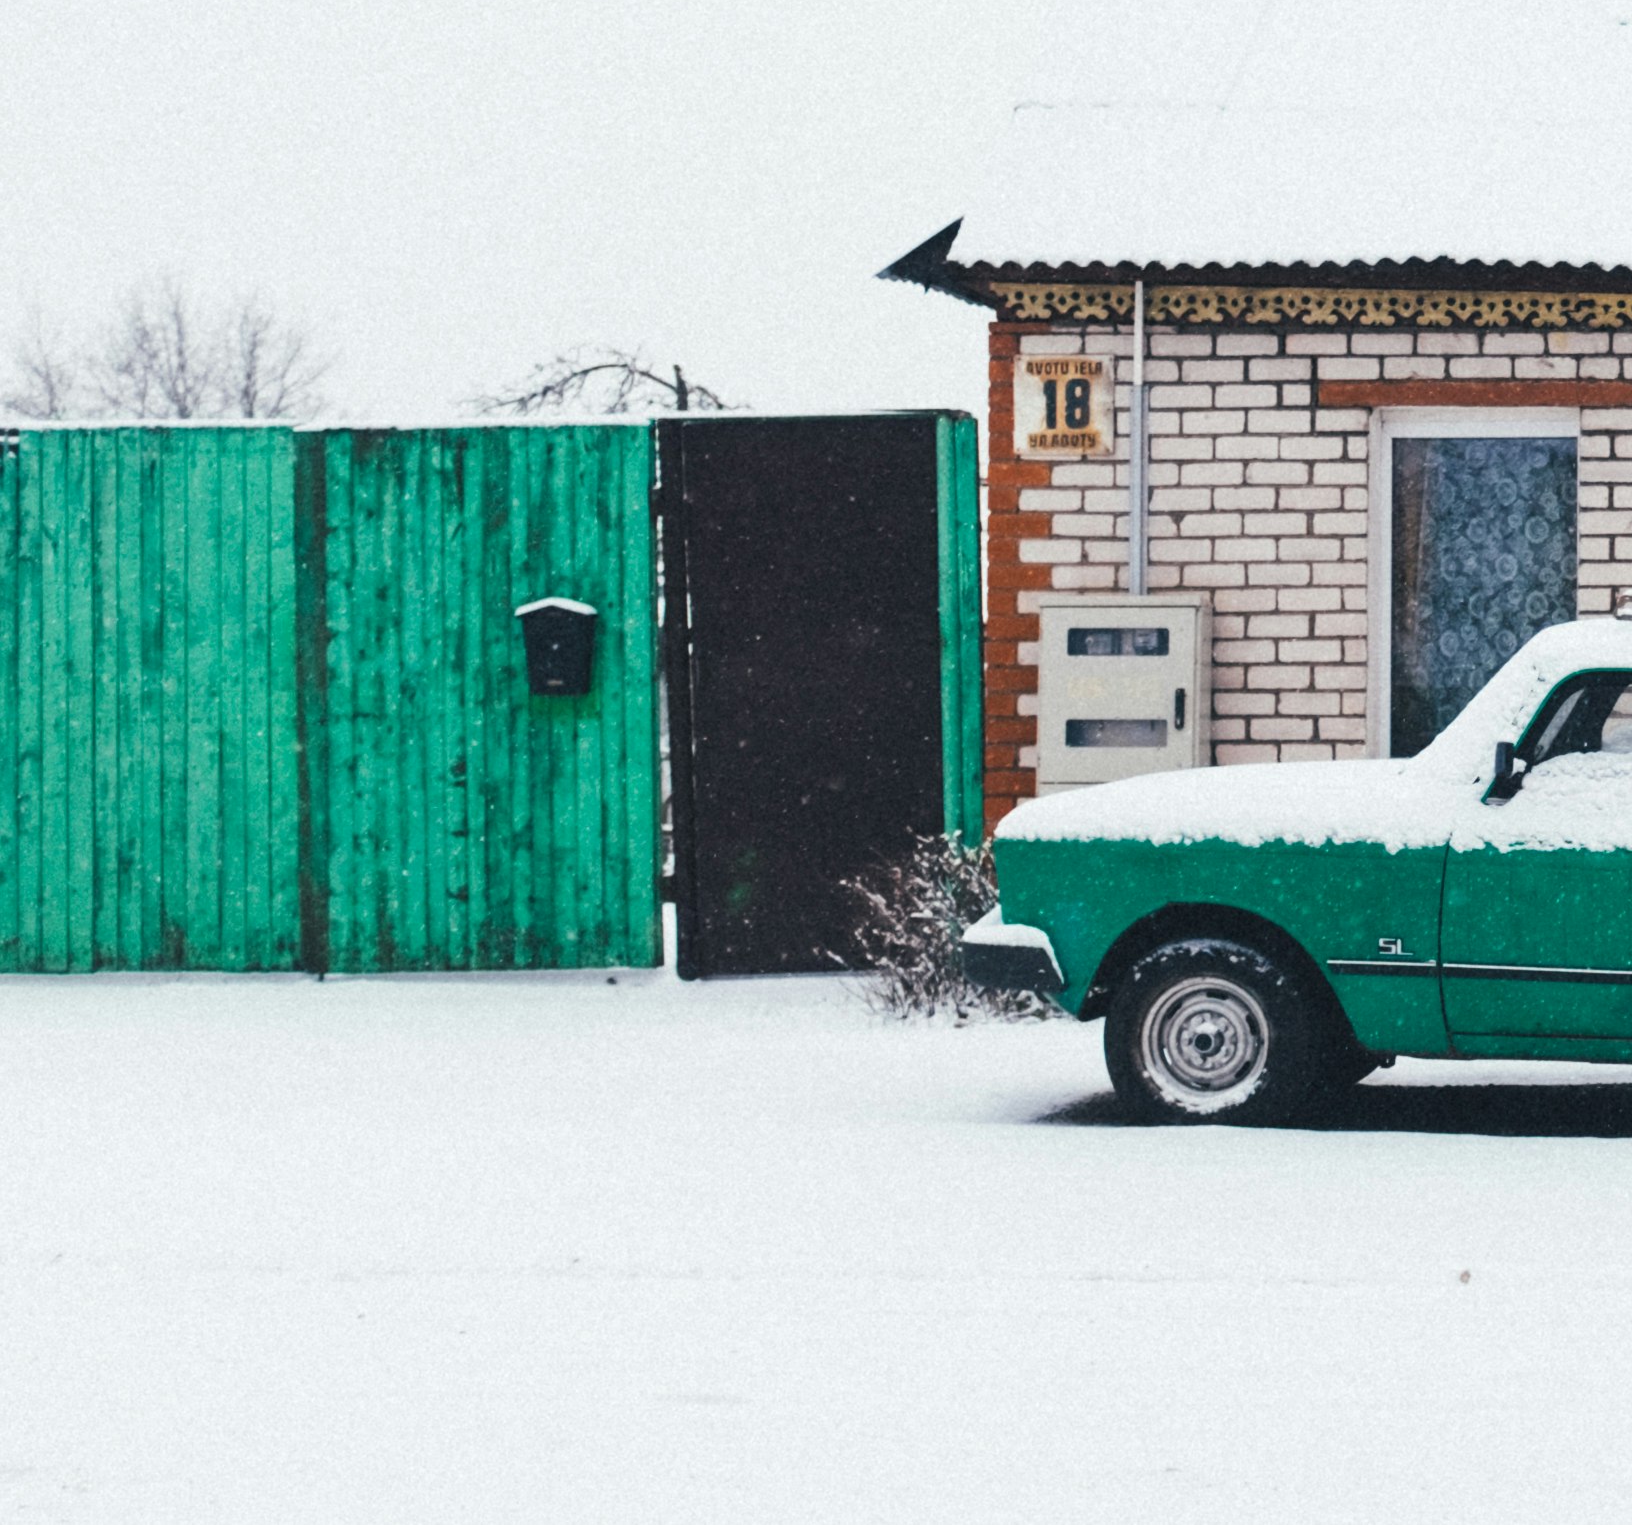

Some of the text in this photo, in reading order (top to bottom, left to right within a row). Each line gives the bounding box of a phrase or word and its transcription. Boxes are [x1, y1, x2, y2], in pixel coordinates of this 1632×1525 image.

[1026, 361, 1069, 375] AVOTU
[1043, 378, 1091, 430] 18
[1378, 937, 1414, 955] SL
